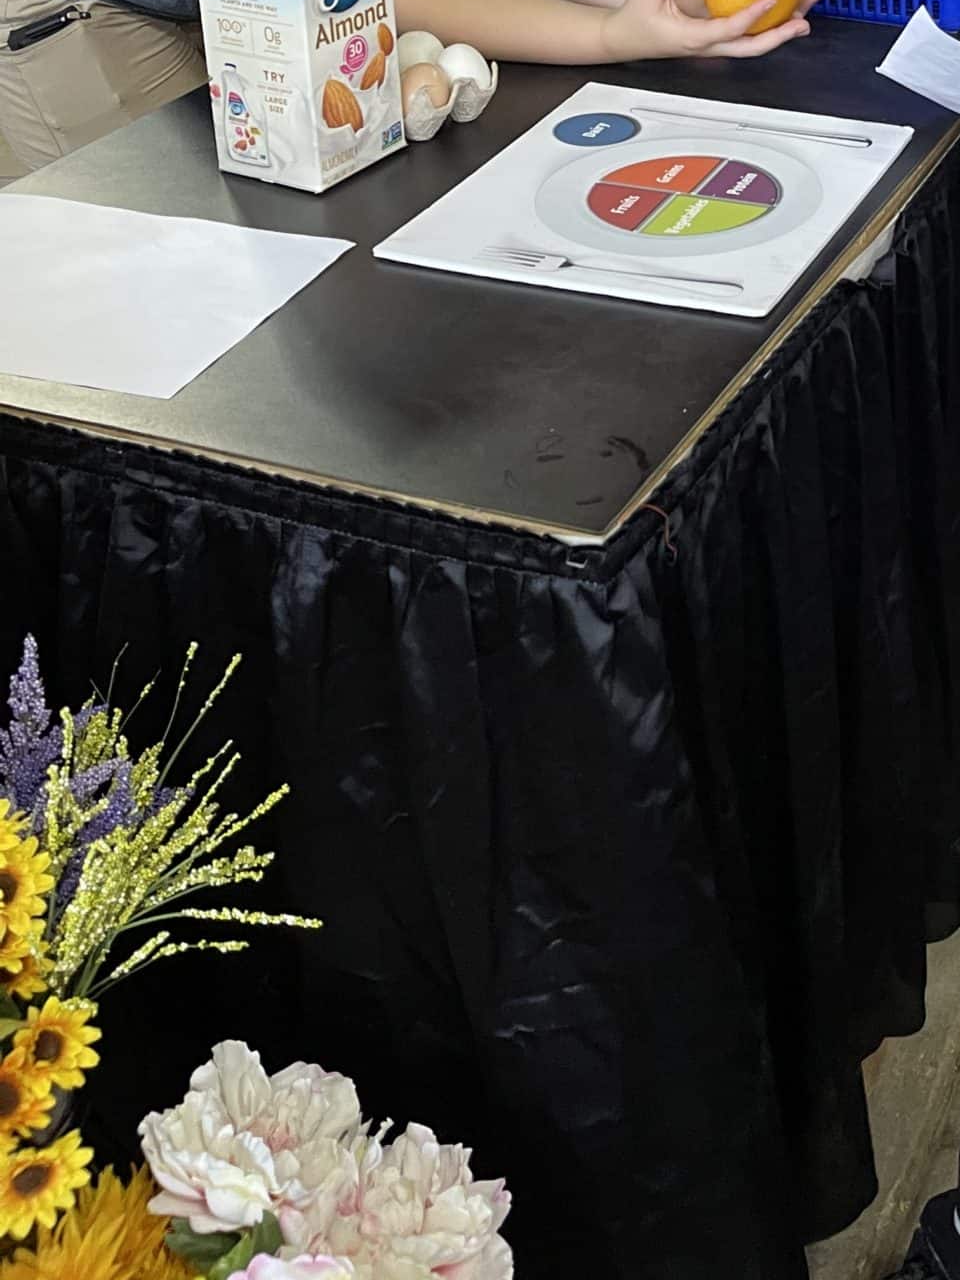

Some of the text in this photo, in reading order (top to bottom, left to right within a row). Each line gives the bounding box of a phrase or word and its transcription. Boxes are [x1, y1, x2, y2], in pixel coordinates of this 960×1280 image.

[263, 25, 282, 46] 0g
[348, 40, 363, 58] 30
[262, 69, 286, 84] TRY
[268, 104, 285, 115] SIZE
[582, 122, 611, 138] Dairy
[655, 164, 685, 183] Grains
[725, 172, 758, 195] Protein
[610, 195, 640, 215] Fruits
[663, 199, 710, 234] Vegetables
